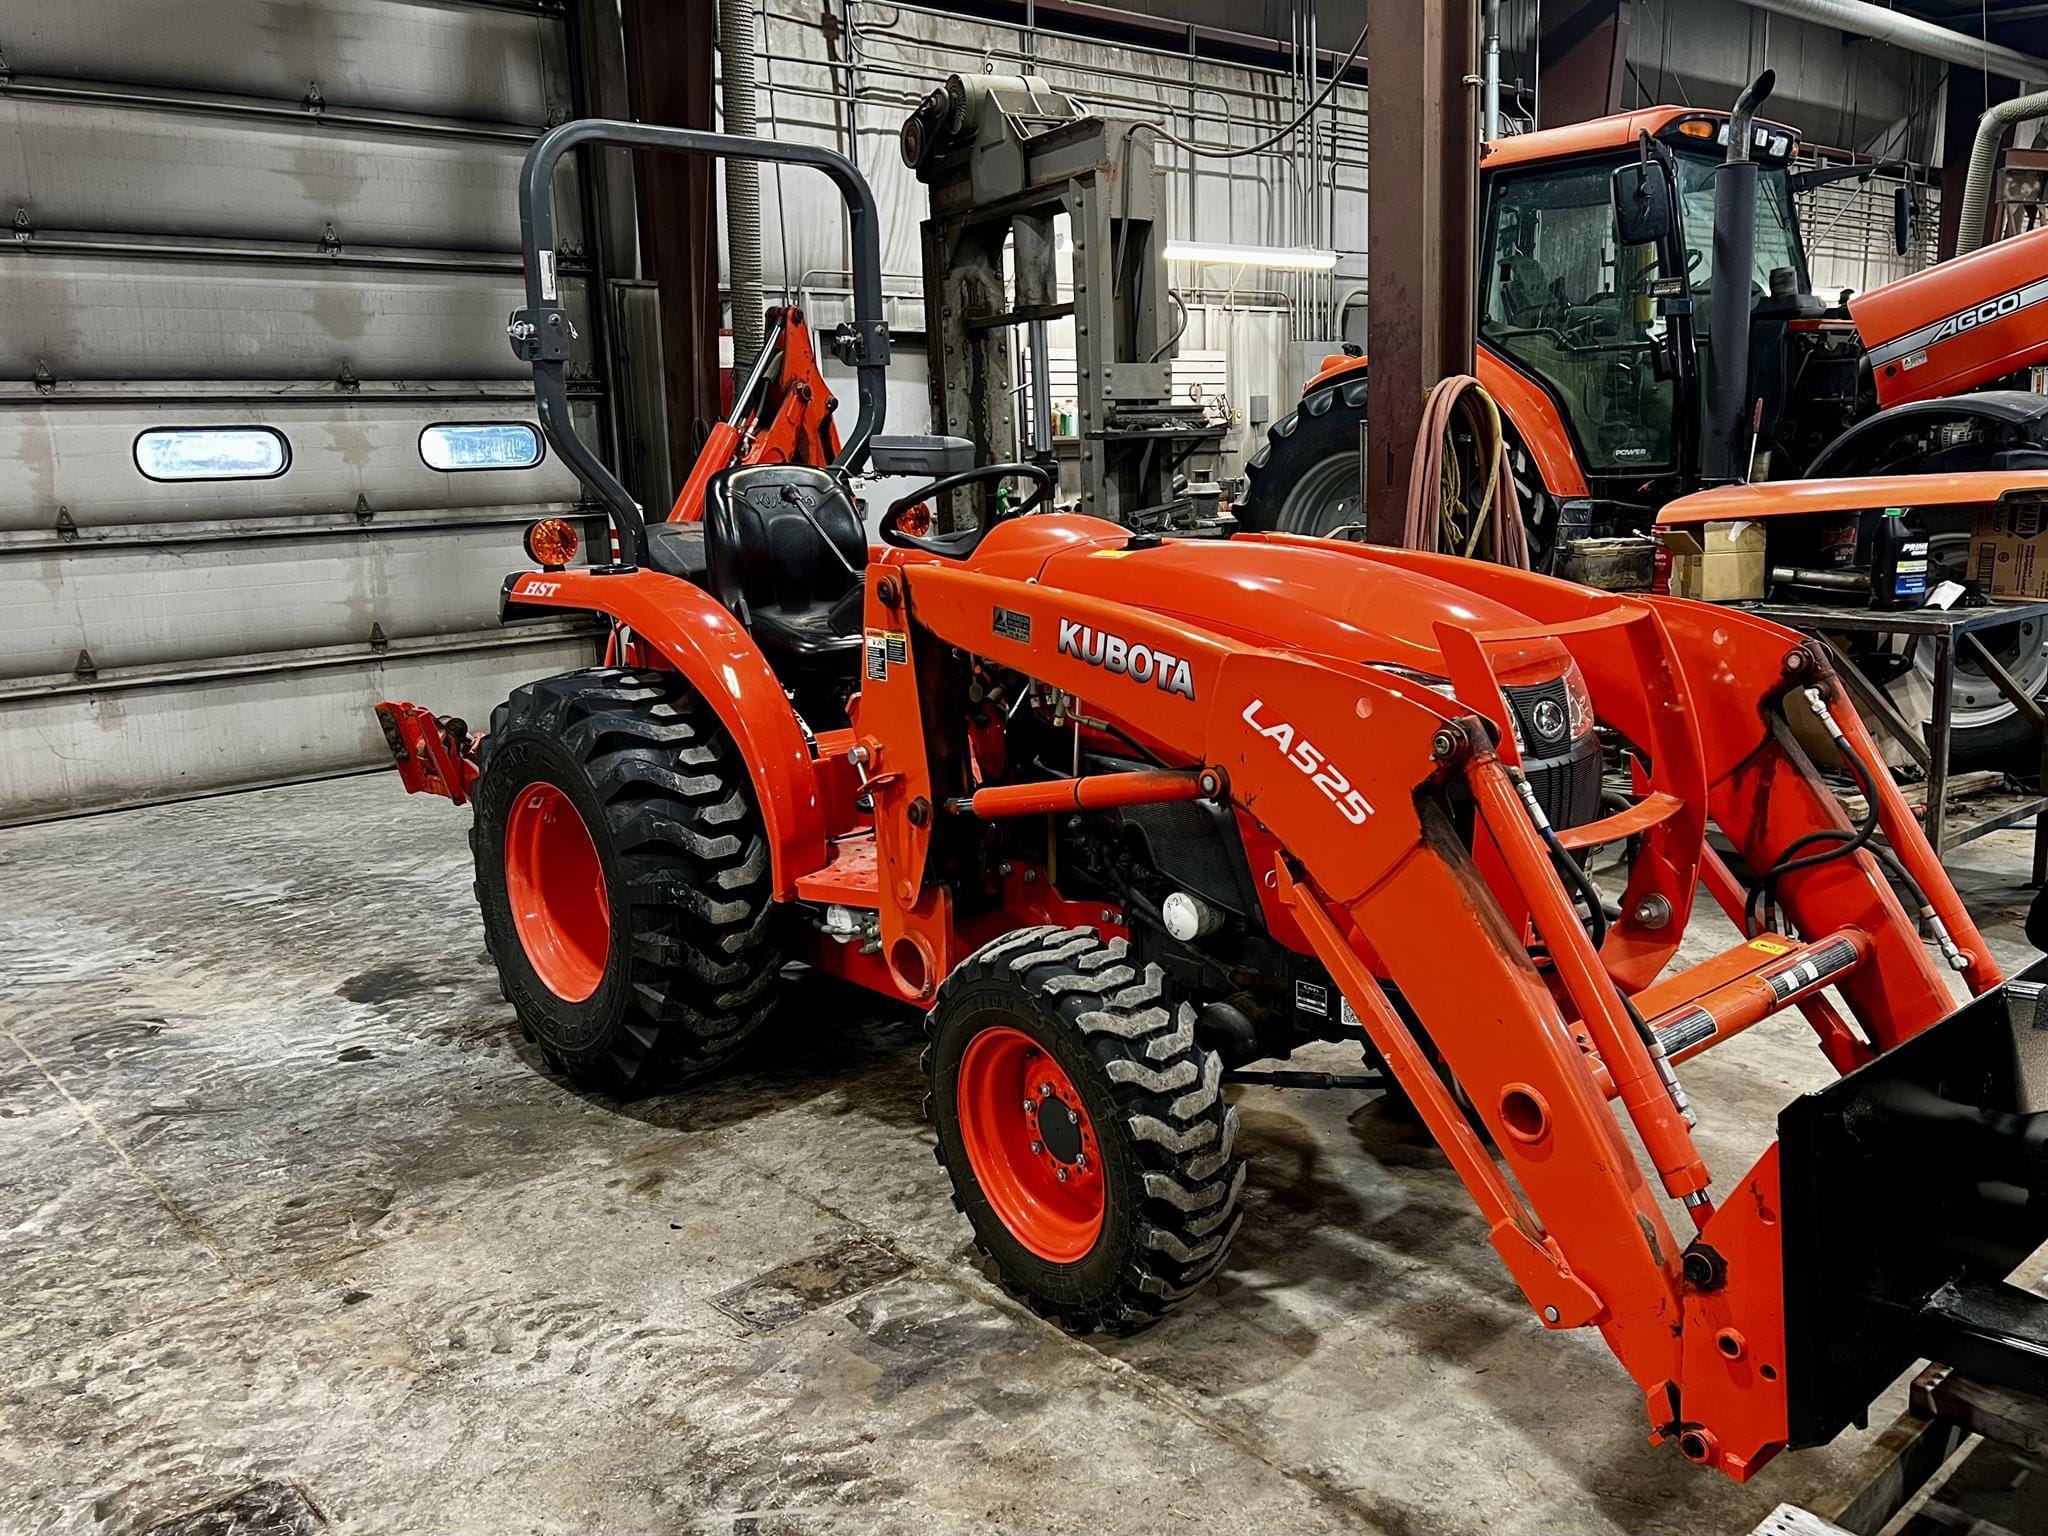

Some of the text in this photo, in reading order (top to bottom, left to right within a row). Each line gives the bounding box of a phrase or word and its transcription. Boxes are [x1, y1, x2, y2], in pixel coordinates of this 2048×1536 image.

[1931, 294, 2019, 342] AGCO
[1615, 448, 1647, 456] POWER
[523, 581, 562, 597] HST
[1058, 618, 1195, 701] KUBOTA
[1242, 698, 1375, 825] LA525
